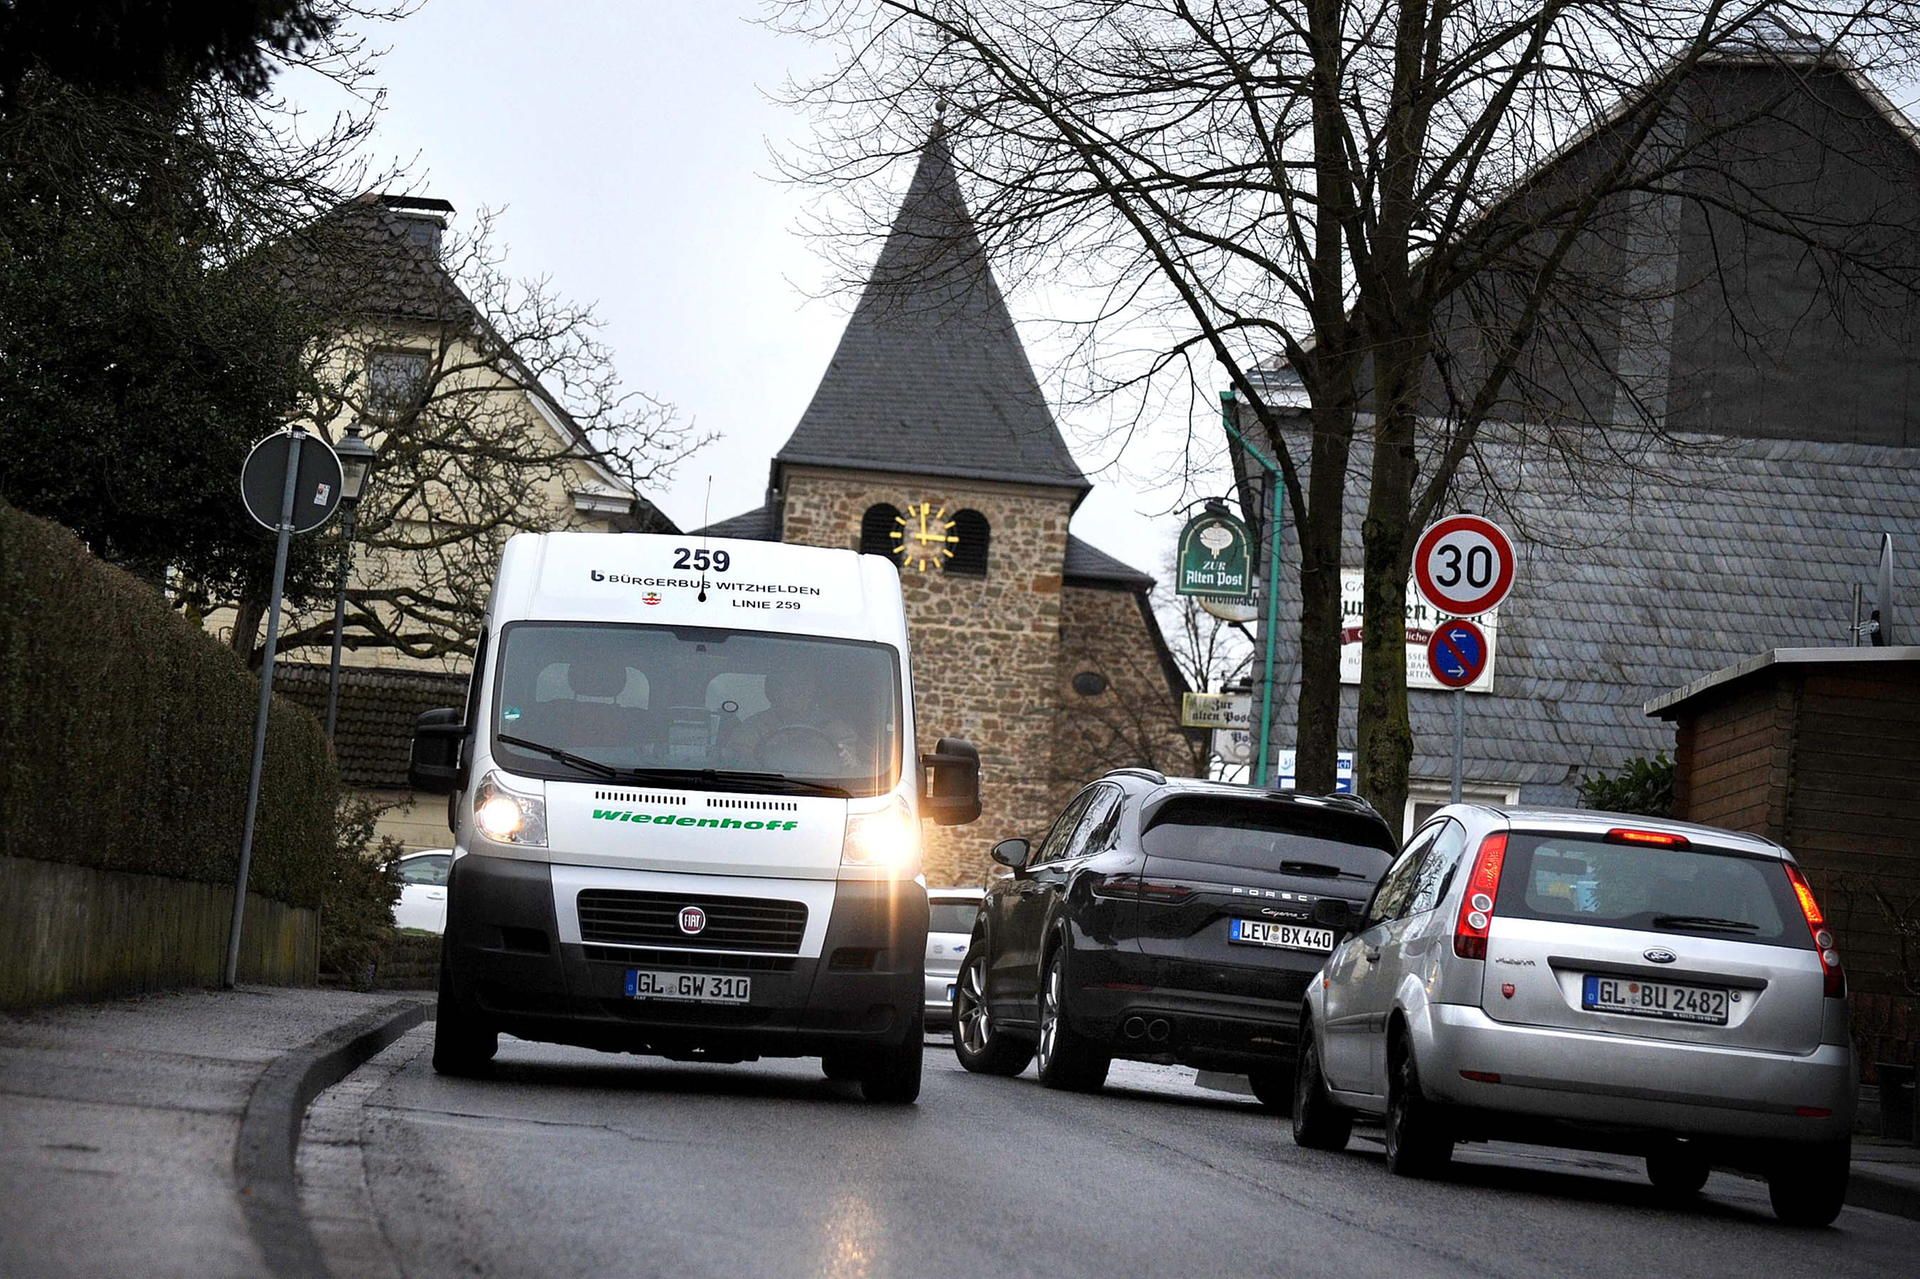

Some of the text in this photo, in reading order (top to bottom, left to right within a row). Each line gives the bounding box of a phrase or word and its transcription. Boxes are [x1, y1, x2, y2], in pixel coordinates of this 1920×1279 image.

[673, 547, 730, 572] 259
[1203, 561, 1227, 571] ZUR
[1436, 544, 1493, 588] 30
[609, 574, 711, 589] BÜRGERBUS
[716, 582, 820, 596] WITZHELDEN
[1186, 570, 1243, 586] Alten Post
[732, 599, 801, 610] LINIE 259
[592, 809, 799, 831] Wiedenhoff
[684, 912, 701, 928] FIAT
[1242, 922, 1271, 940] LEV
[1281, 927, 1301, 945] BX
[1303, 930, 1331, 948] 440
[638, 973, 664, 994] GL
[678, 976, 705, 996] GW
[710, 977, 749, 999] 310
[1600, 981, 1625, 1004] GL
[1641, 985, 1668, 1009] BU
[1673, 989, 1724, 1016] 2482
